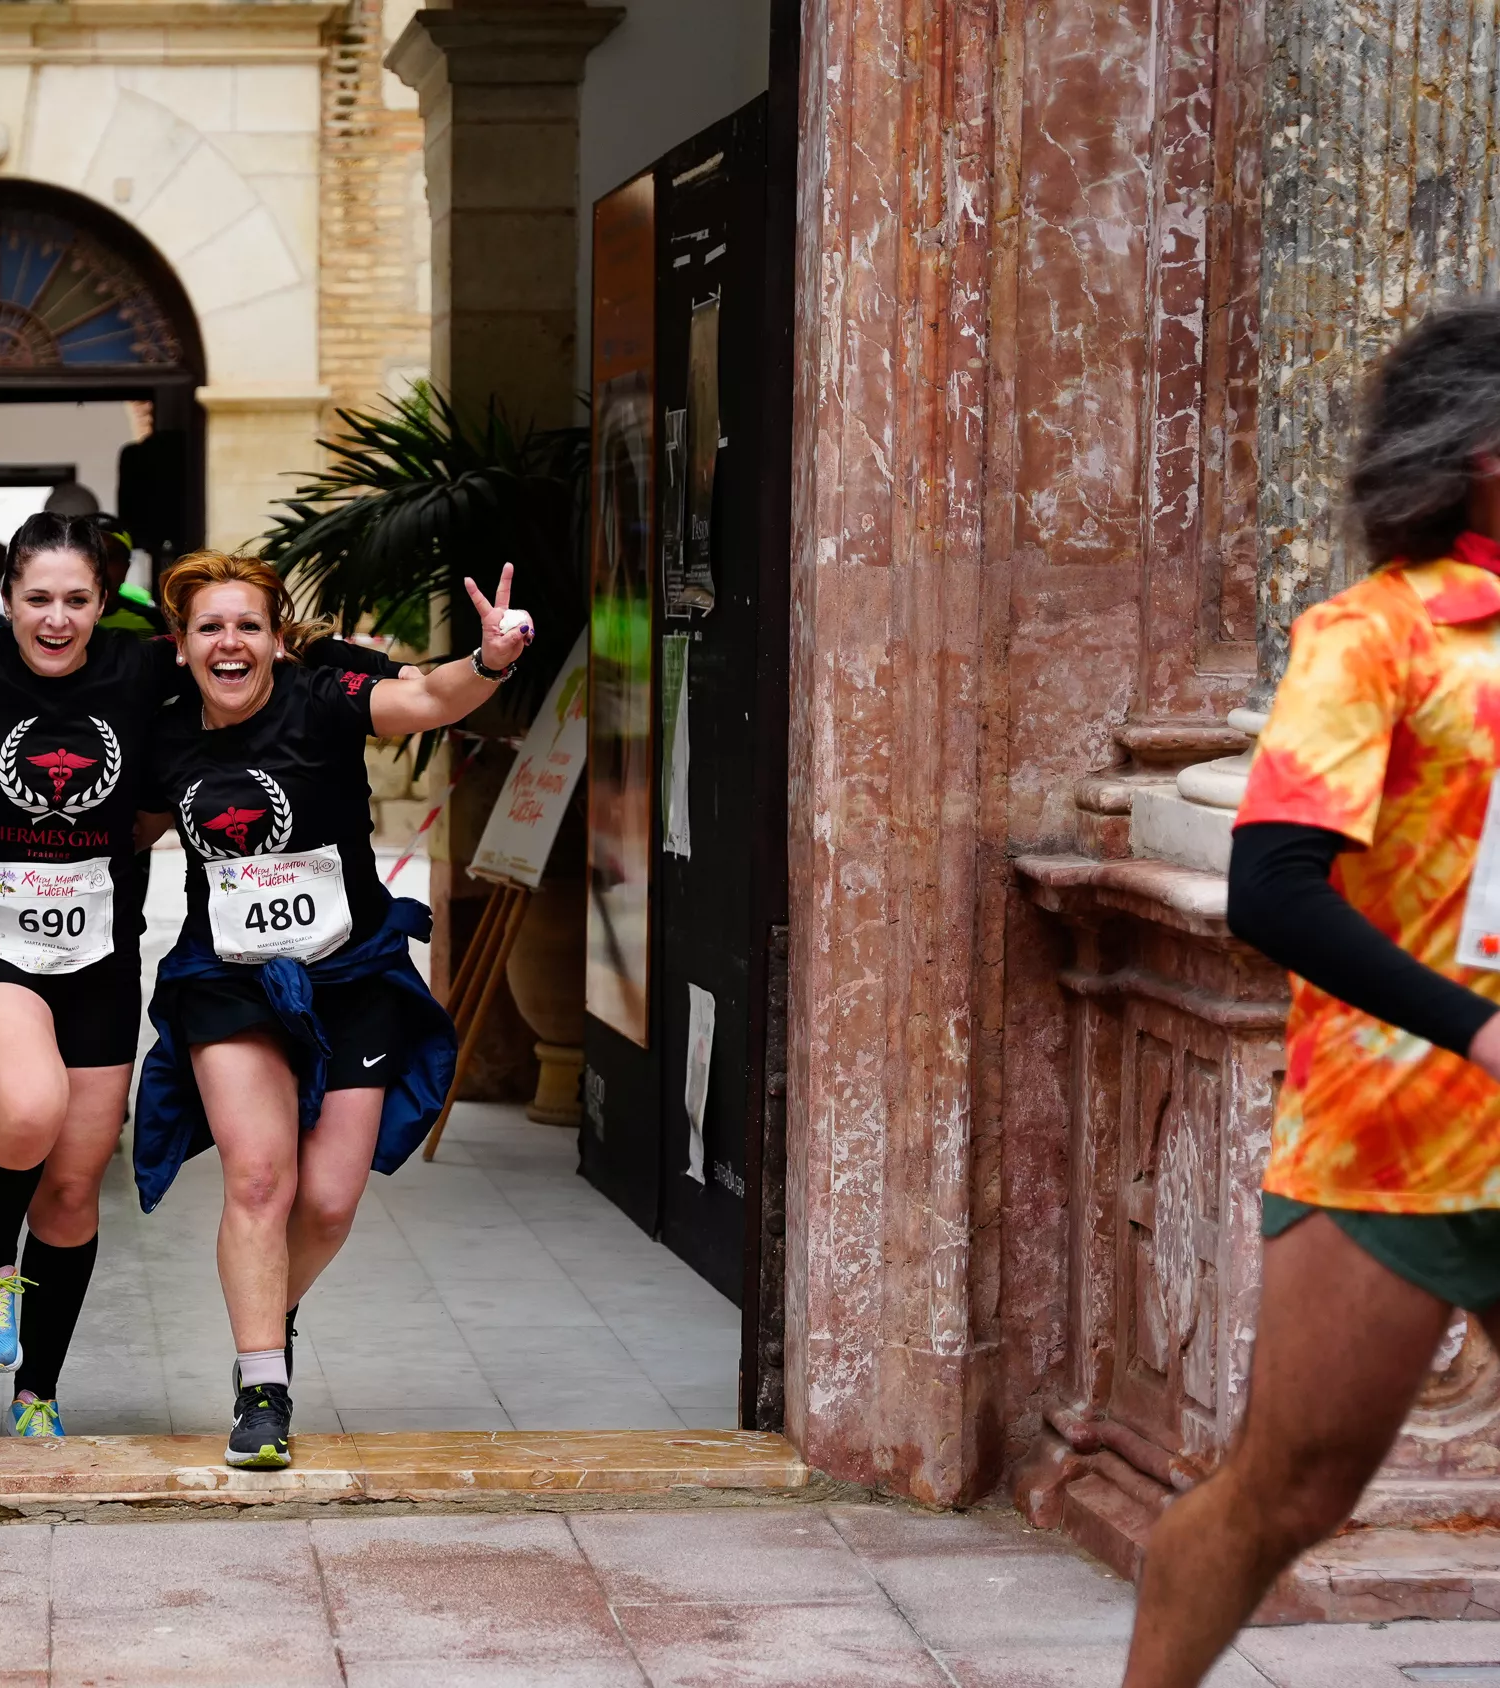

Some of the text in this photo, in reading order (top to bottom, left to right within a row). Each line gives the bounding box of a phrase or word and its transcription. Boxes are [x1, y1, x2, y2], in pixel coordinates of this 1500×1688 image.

[68, 830, 109, 847] GYM
[26, 848, 71, 859] Training
[21, 870, 36, 887] X
[240, 863, 254, 880] X
[257, 872, 299, 888] LUCENA
[37, 885, 76, 897] LUCENA
[18, 906, 86, 937] 690
[245, 893, 316, 933] 480
